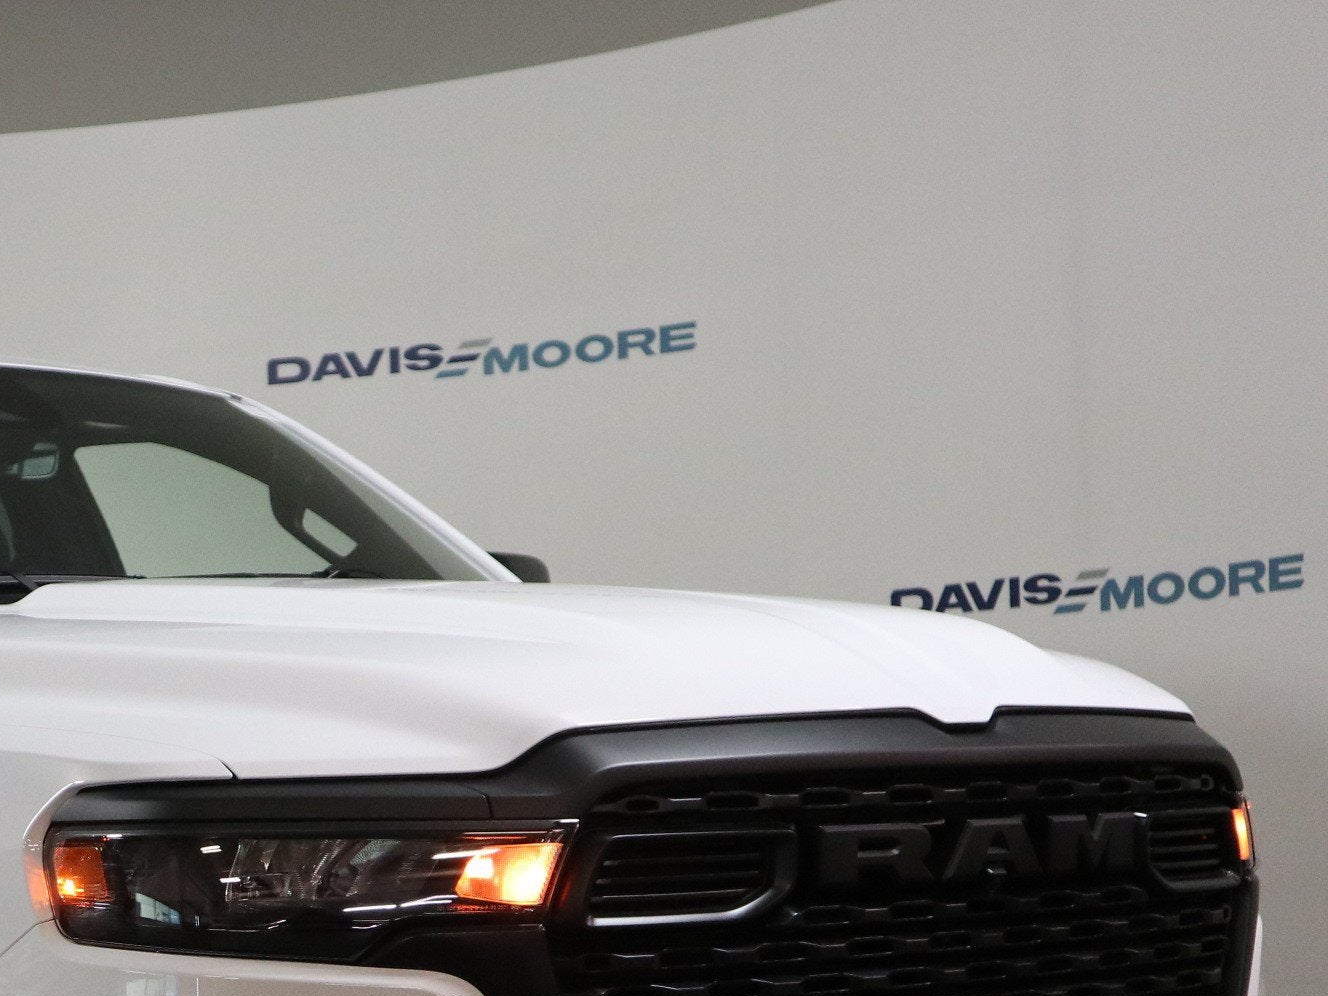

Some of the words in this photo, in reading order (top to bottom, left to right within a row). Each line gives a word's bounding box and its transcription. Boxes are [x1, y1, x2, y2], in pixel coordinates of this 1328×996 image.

[266, 342, 445, 385] DAVIS
[483, 320, 697, 375] MOORE
[1100, 553, 1305, 612] MOORE
[818, 812, 1139, 881] RAM
